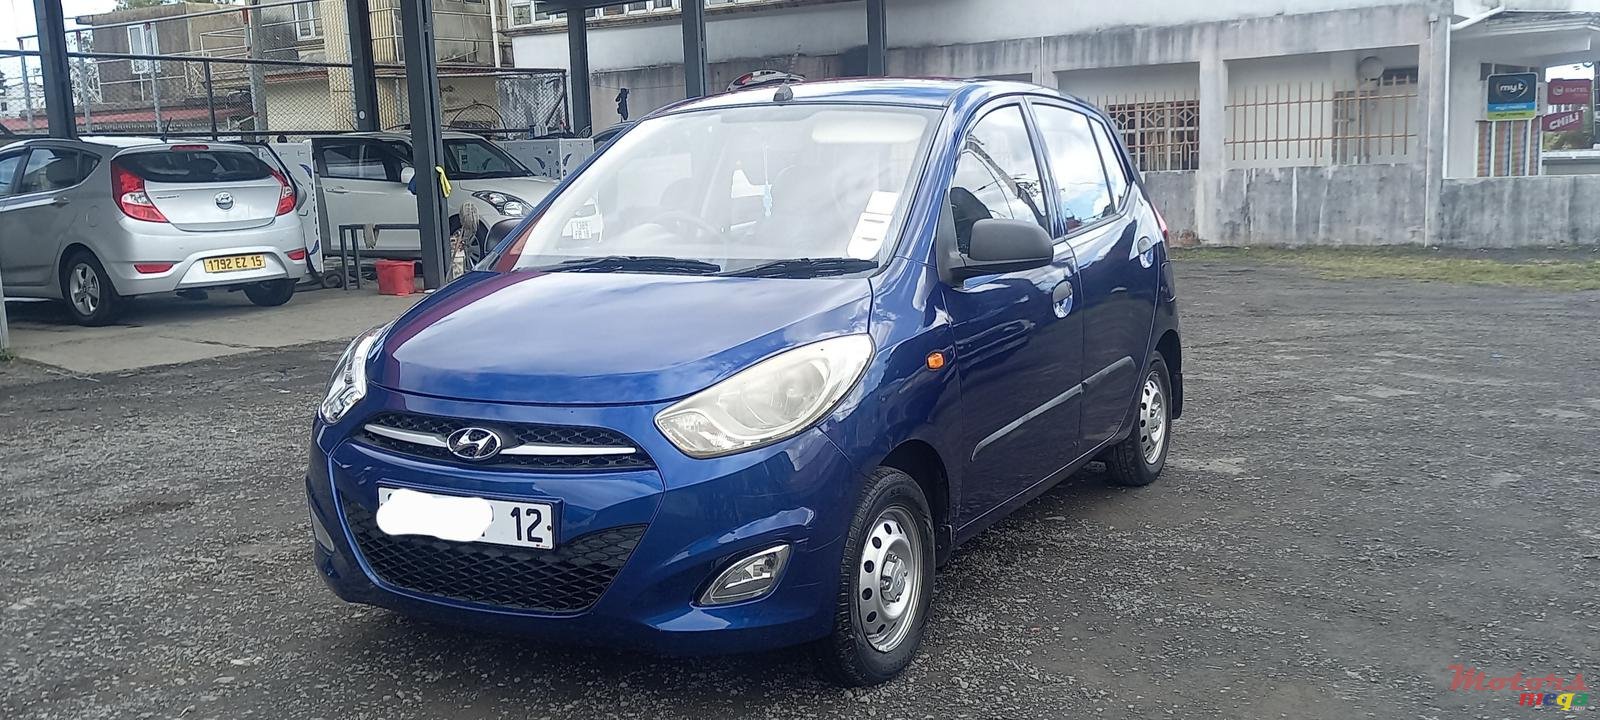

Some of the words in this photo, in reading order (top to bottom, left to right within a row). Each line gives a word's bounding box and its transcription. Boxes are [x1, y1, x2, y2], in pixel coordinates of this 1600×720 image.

[208, 258, 233, 271] 1792
[235, 257, 247, 268] EZ
[251, 256, 262, 267] 15
[510, 506, 543, 543] 12
